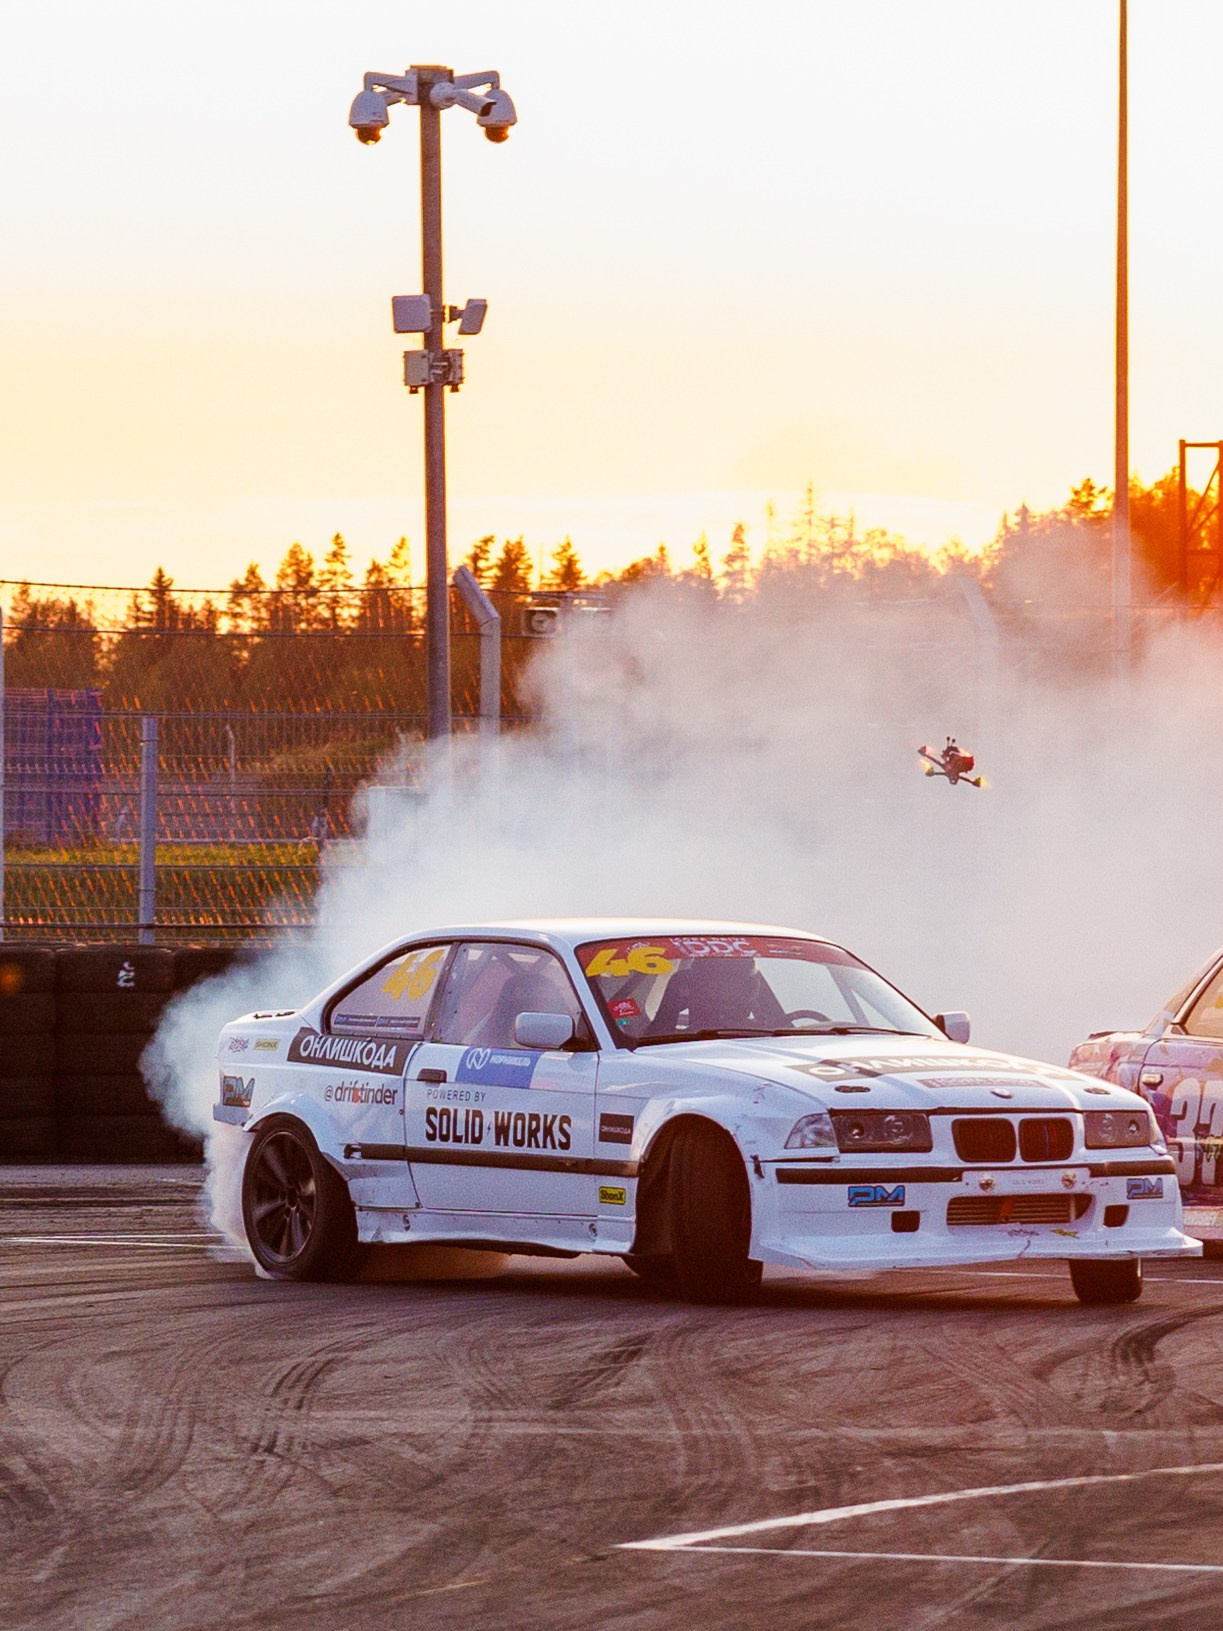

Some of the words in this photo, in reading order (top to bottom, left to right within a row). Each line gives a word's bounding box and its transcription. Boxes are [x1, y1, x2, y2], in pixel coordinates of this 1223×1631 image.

[383, 949, 445, 1001] 46
[586, 947, 673, 977] 46
[300, 1034, 397, 1070] ОНЛИШКОДА
[426, 1088, 471, 1101] POWERED
[474, 1091, 487, 1102] BY
[425, 1106, 484, 1144] SOLID
[494, 1110, 572, 1150] WORKS
